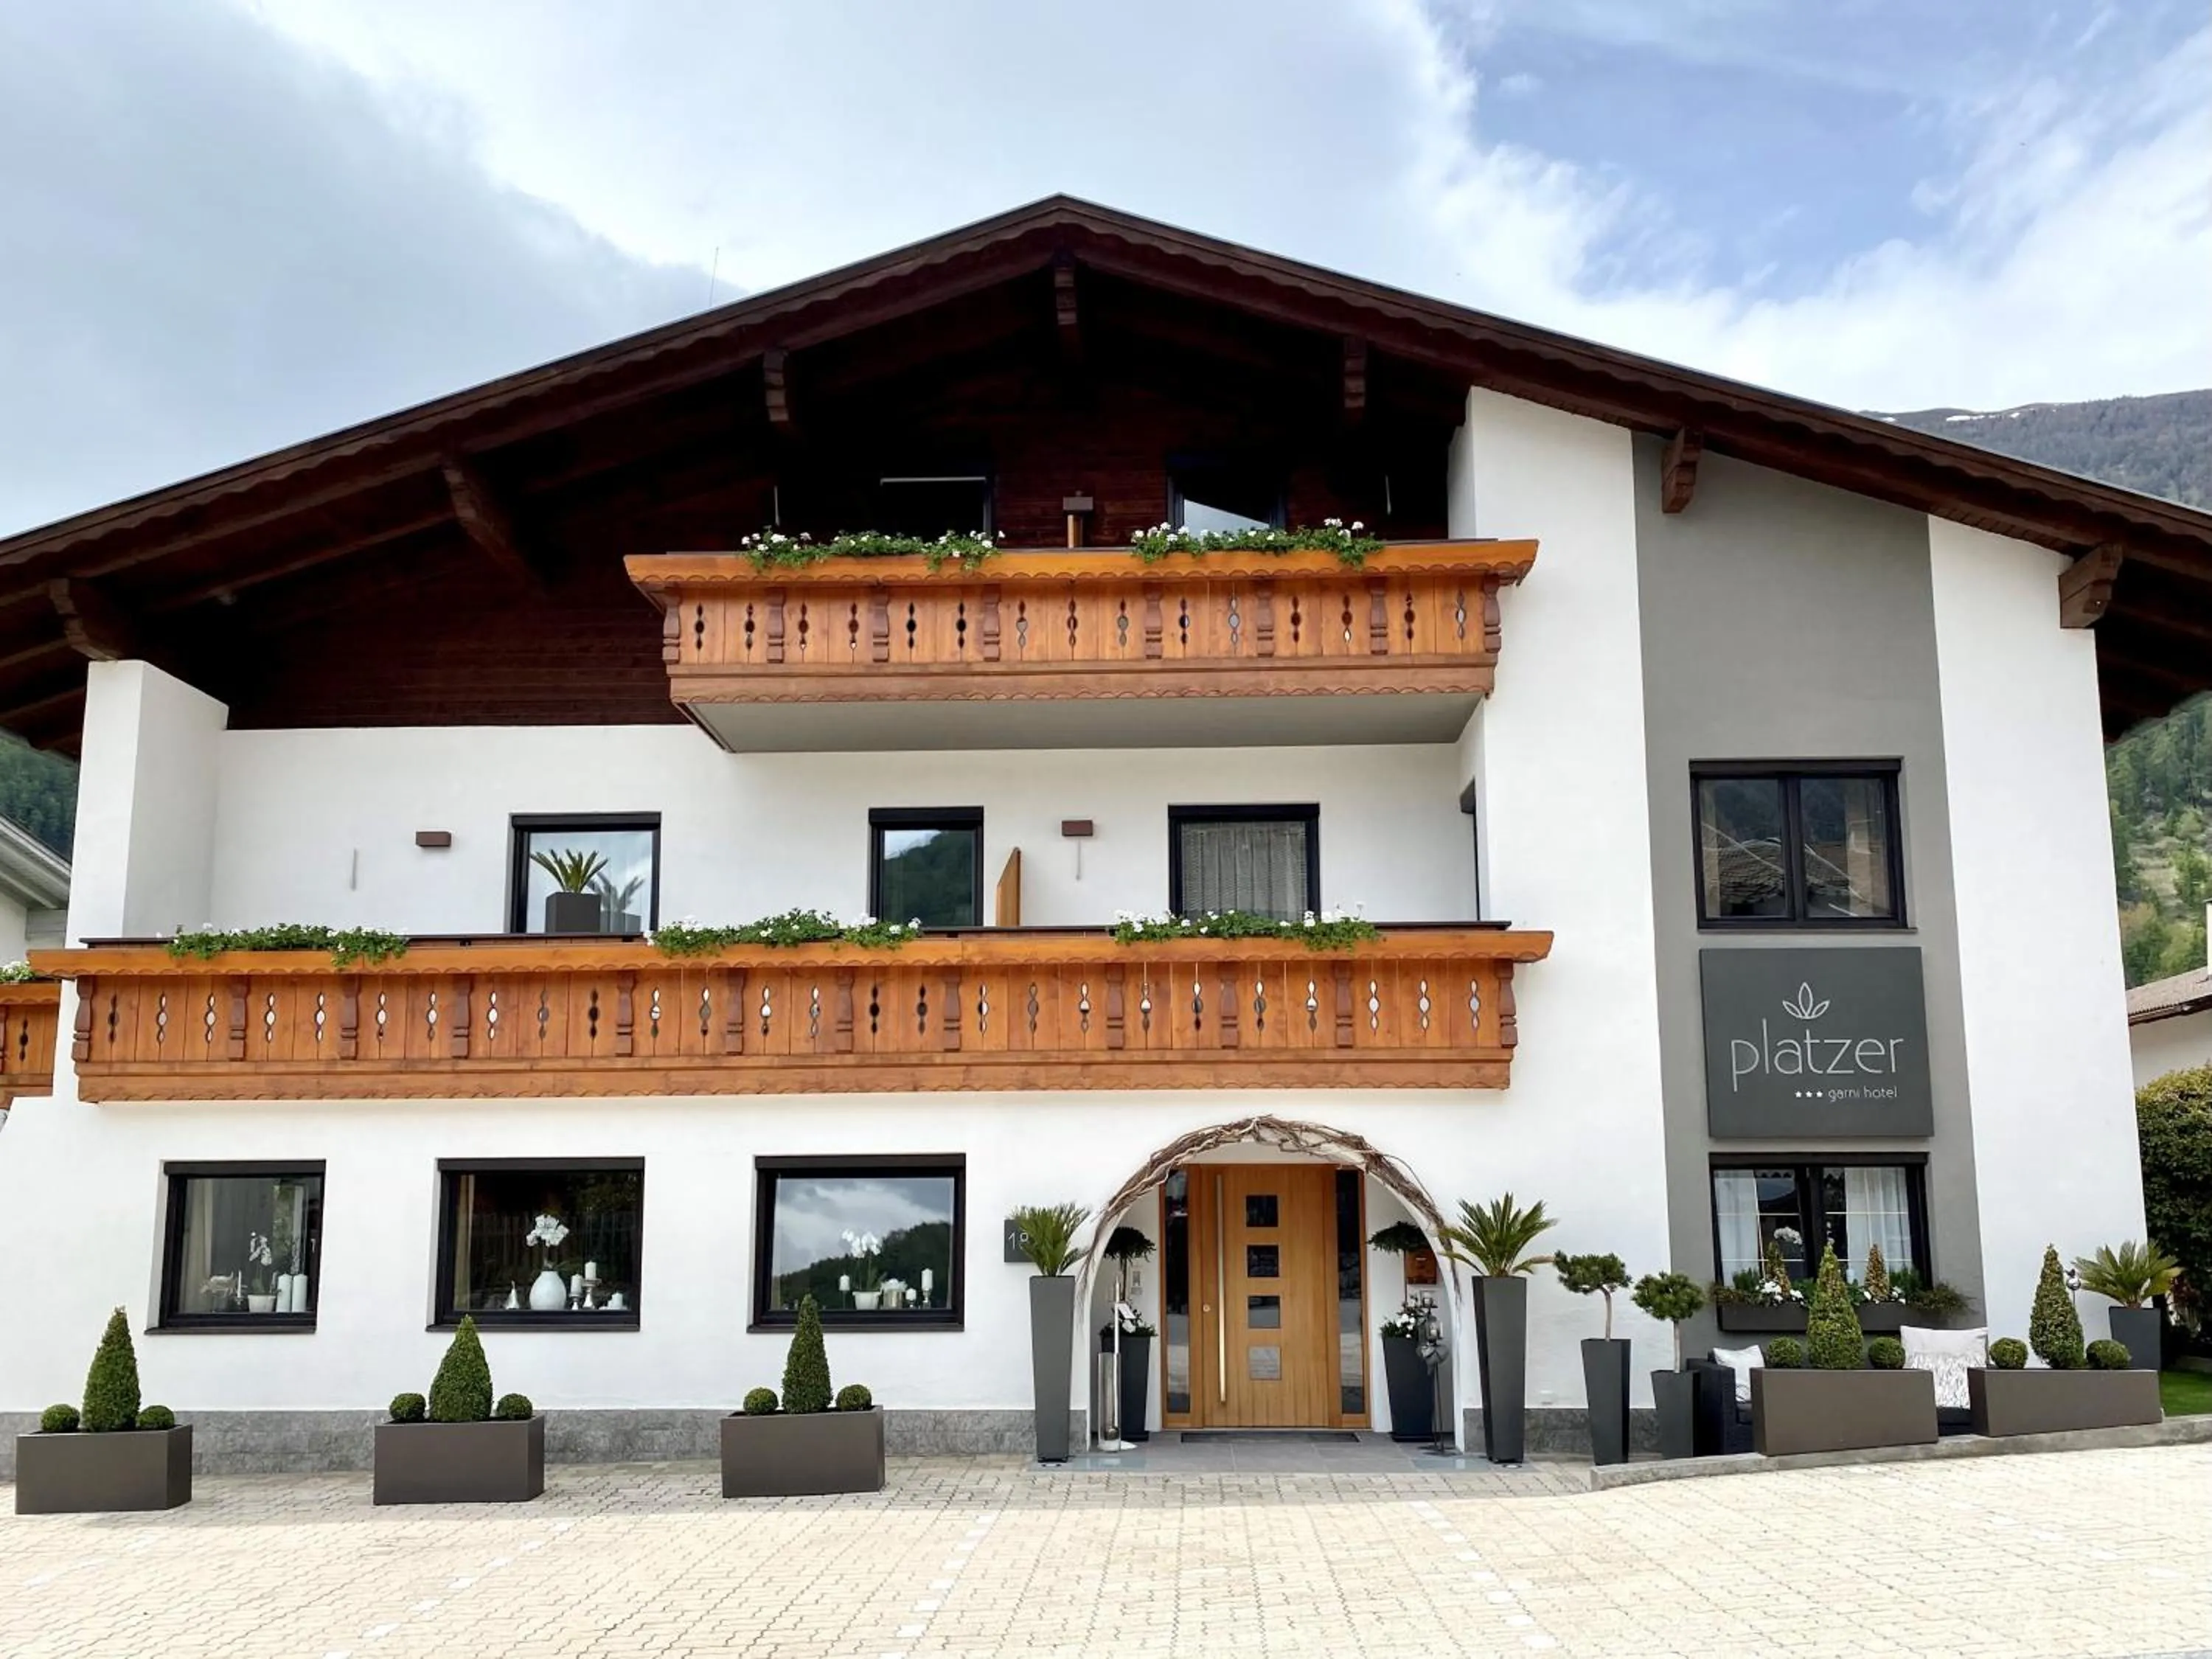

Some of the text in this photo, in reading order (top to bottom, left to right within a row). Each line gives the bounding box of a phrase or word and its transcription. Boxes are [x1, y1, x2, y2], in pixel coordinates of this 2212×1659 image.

[1731, 1018, 1904, 1092] platzer
[1828, 1085, 1897, 1102] garni hotel
